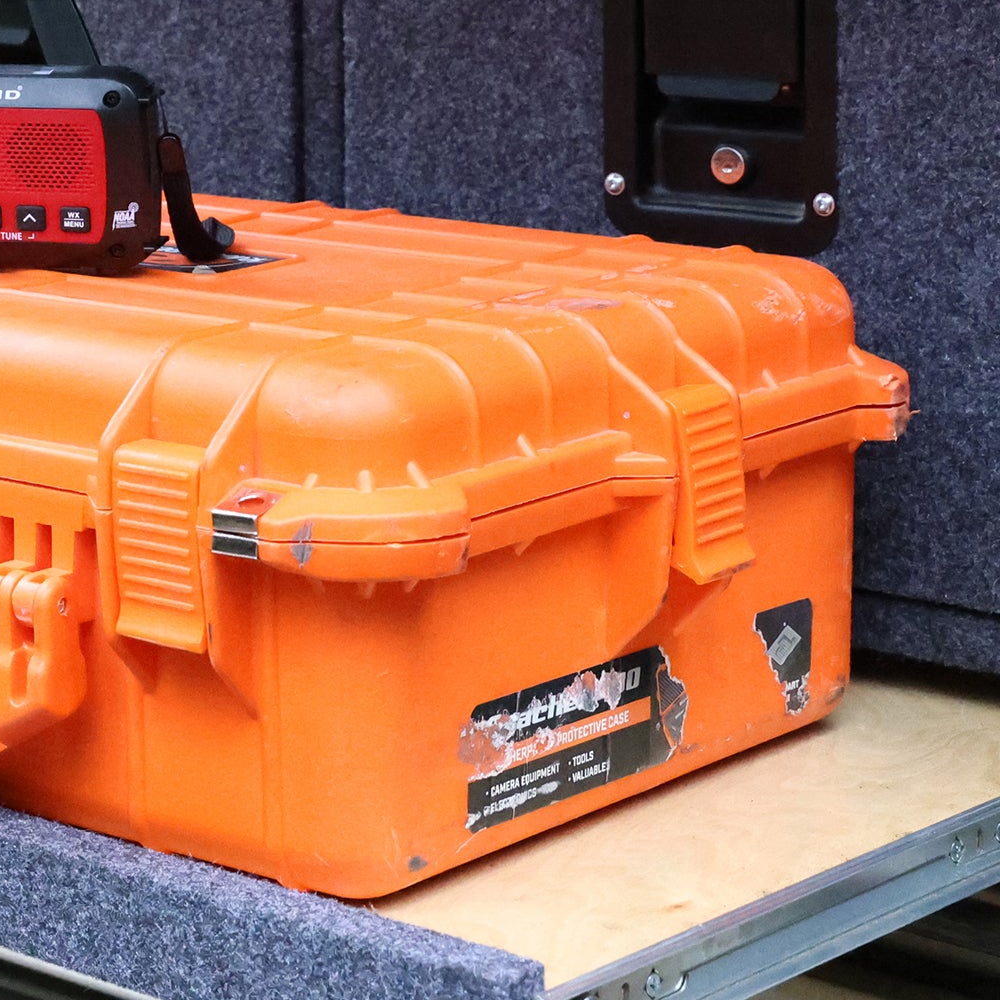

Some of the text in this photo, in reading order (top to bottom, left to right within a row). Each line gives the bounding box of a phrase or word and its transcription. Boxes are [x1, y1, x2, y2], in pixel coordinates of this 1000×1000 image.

[63, 220, 84, 228] MENU
[0, 231, 22, 240] TUNE
[557, 717, 608, 745] PROTECTIVE
[608, 711, 630, 729] CASE
[572, 750, 595, 767] TOOLS
[490, 762, 560, 797] CAMERA EQUIPMENT
